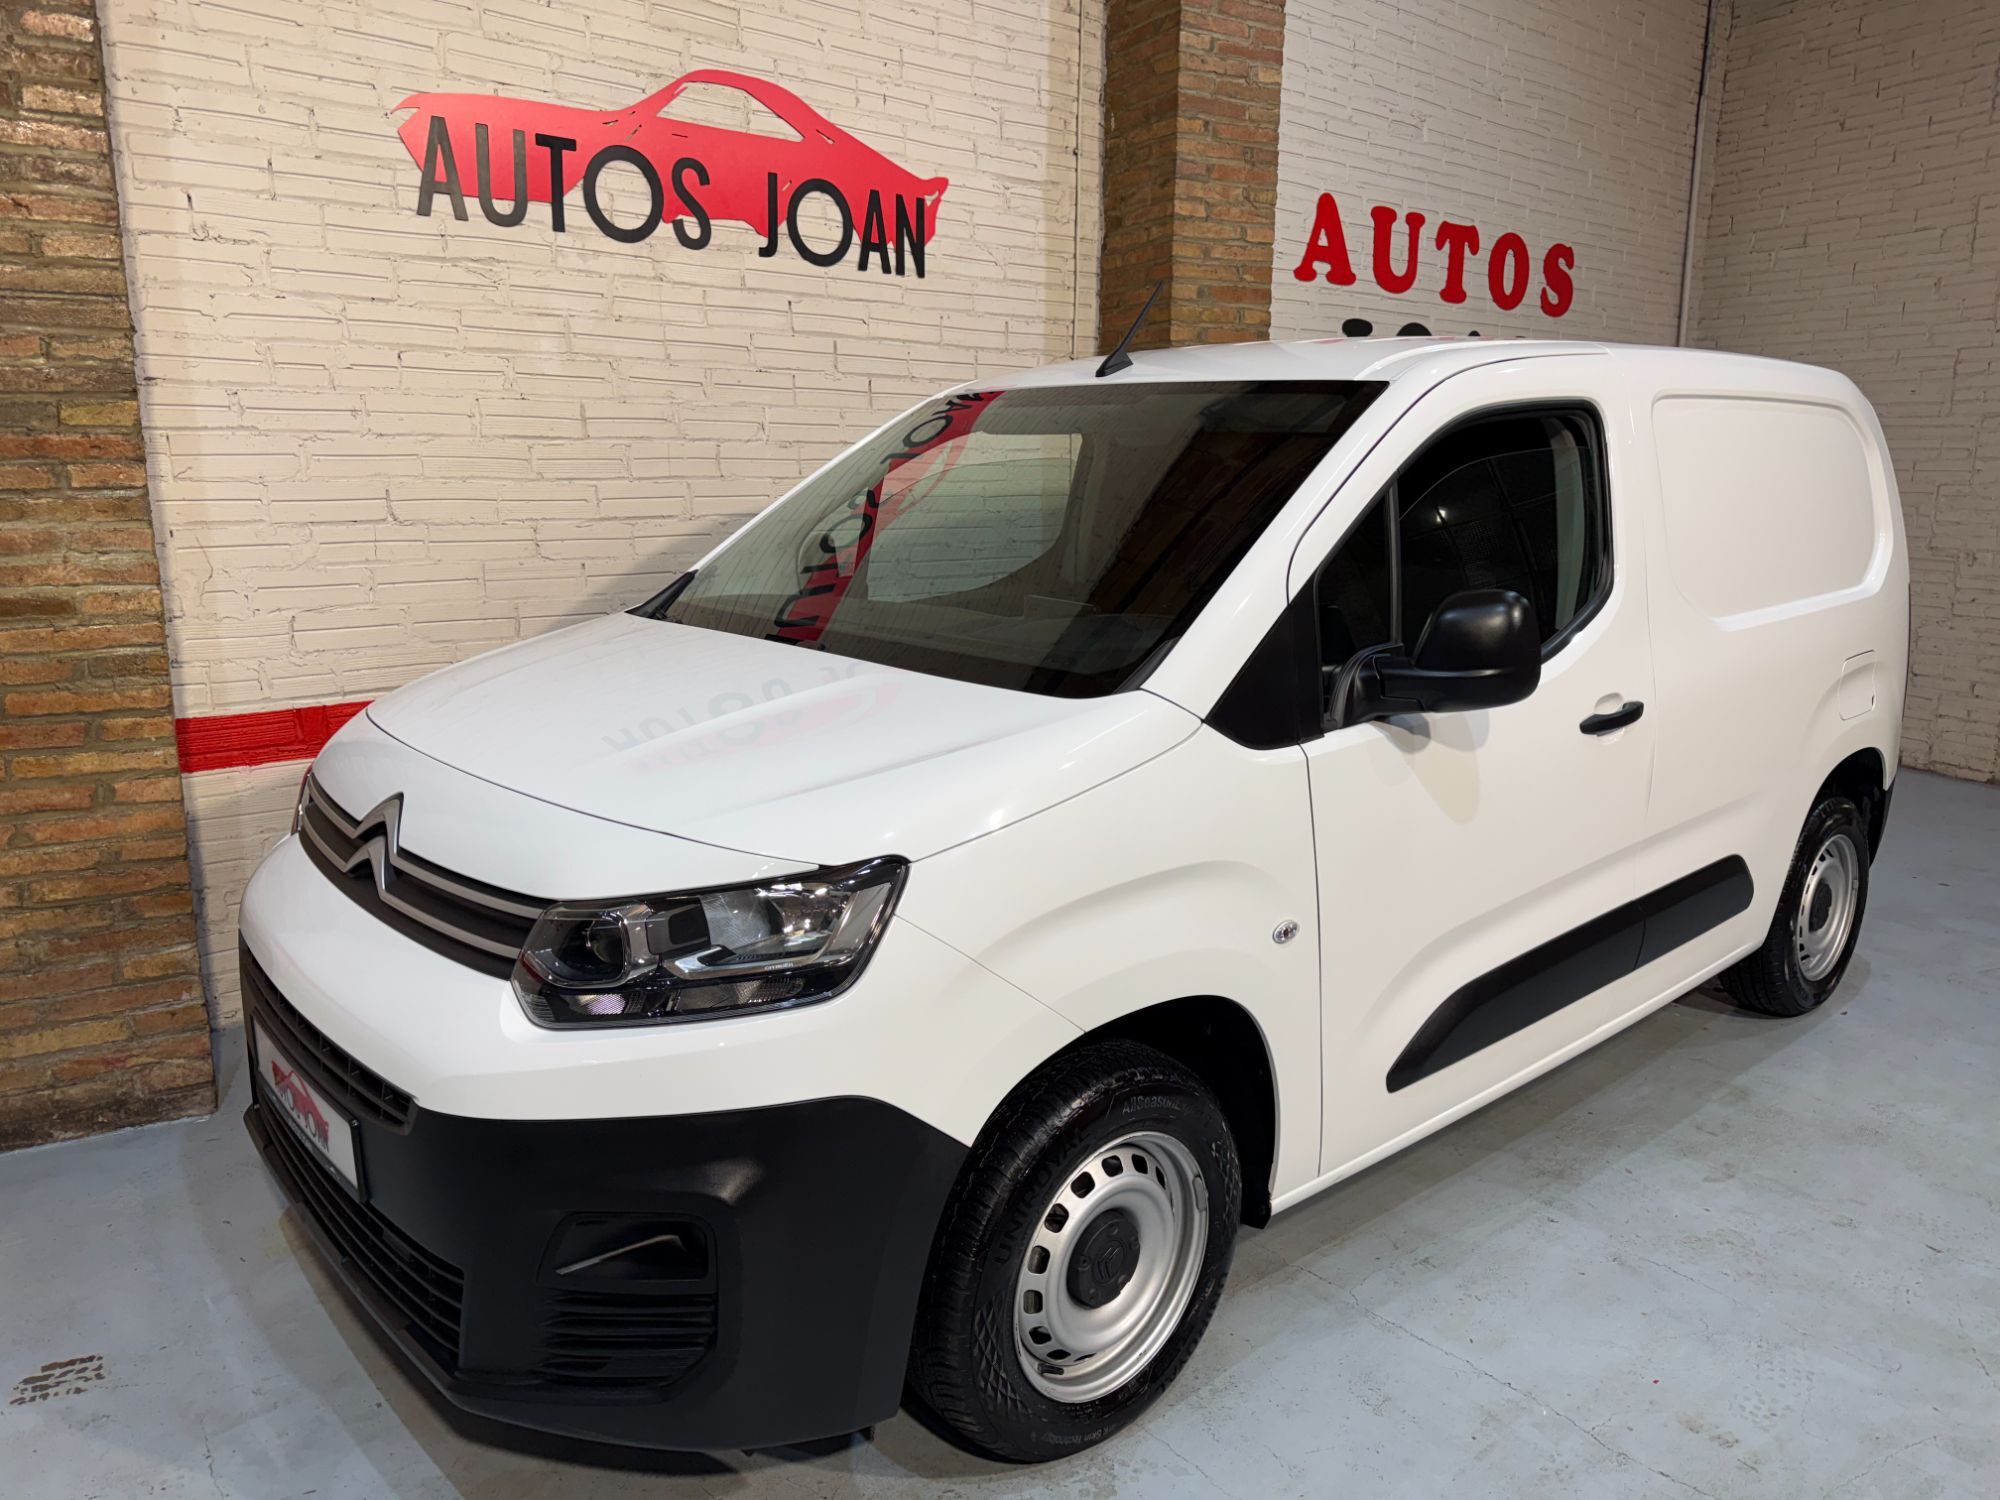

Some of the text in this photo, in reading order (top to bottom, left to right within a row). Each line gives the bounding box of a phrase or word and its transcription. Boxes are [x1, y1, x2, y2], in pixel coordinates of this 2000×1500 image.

[416, 115, 926, 278] AUTOS JOAN
[1293, 192, 1574, 317] AUTOS
